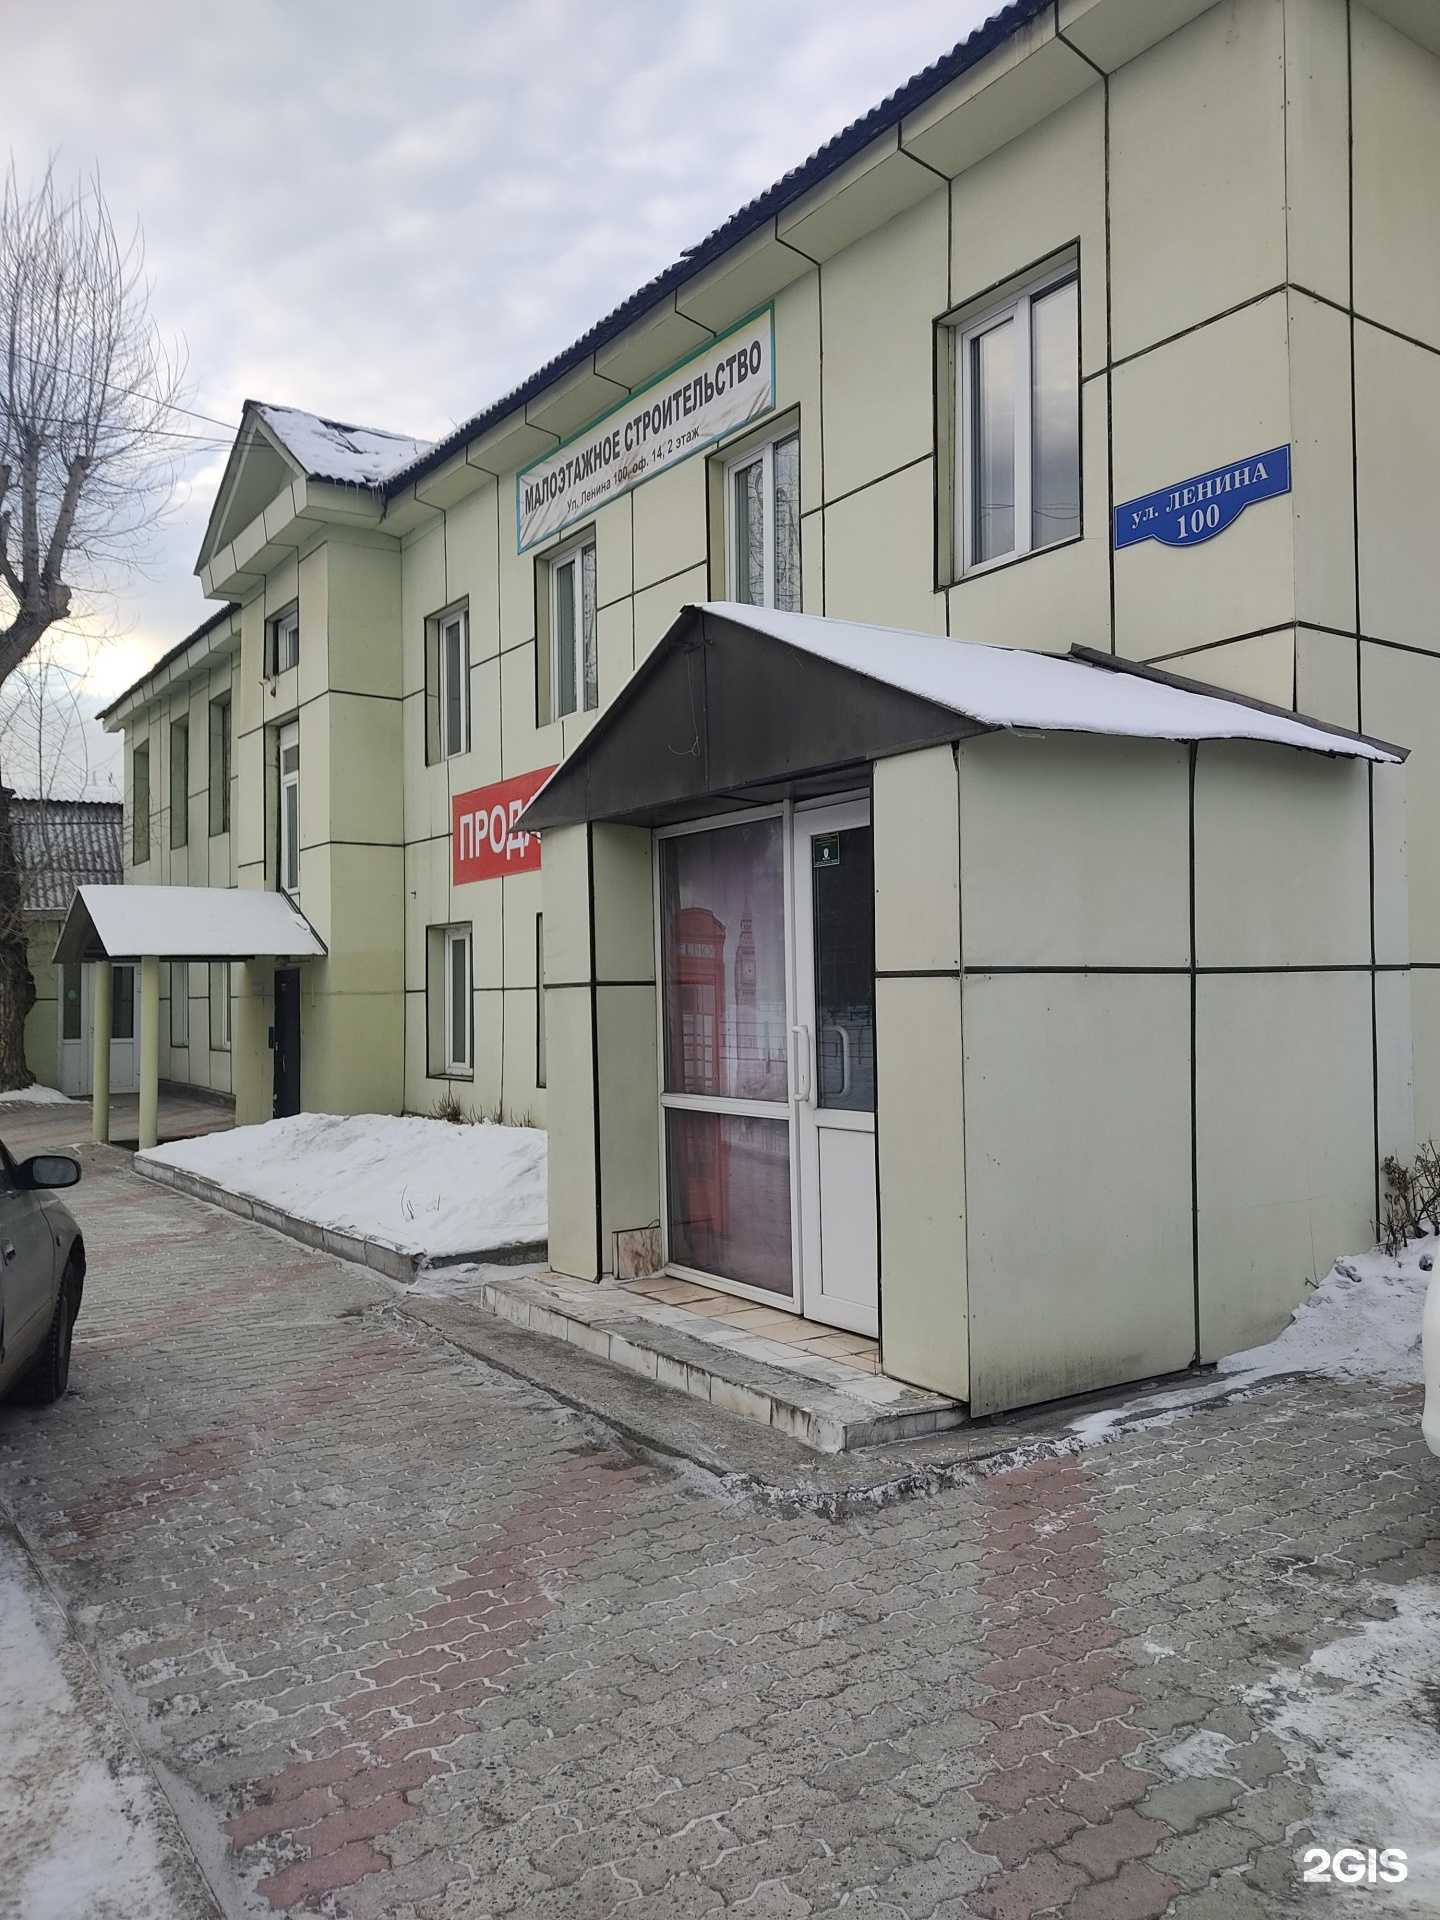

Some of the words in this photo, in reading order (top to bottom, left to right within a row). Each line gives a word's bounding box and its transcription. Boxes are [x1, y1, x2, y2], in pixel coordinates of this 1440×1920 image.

[525, 430, 620, 514] МАЛОЭТАЖНОЕ
[624, 340, 761, 452] СТРОИТЕЛЬСТВО
[581, 479, 611, 505] Ленина
[667, 439, 673, 454] 2
[675, 425, 700, 449] этаж
[1131, 507, 1159, 529] ул.
[1166, 462, 1269, 512] ЛЕНИНА
[1177, 503, 1220, 539] 100
